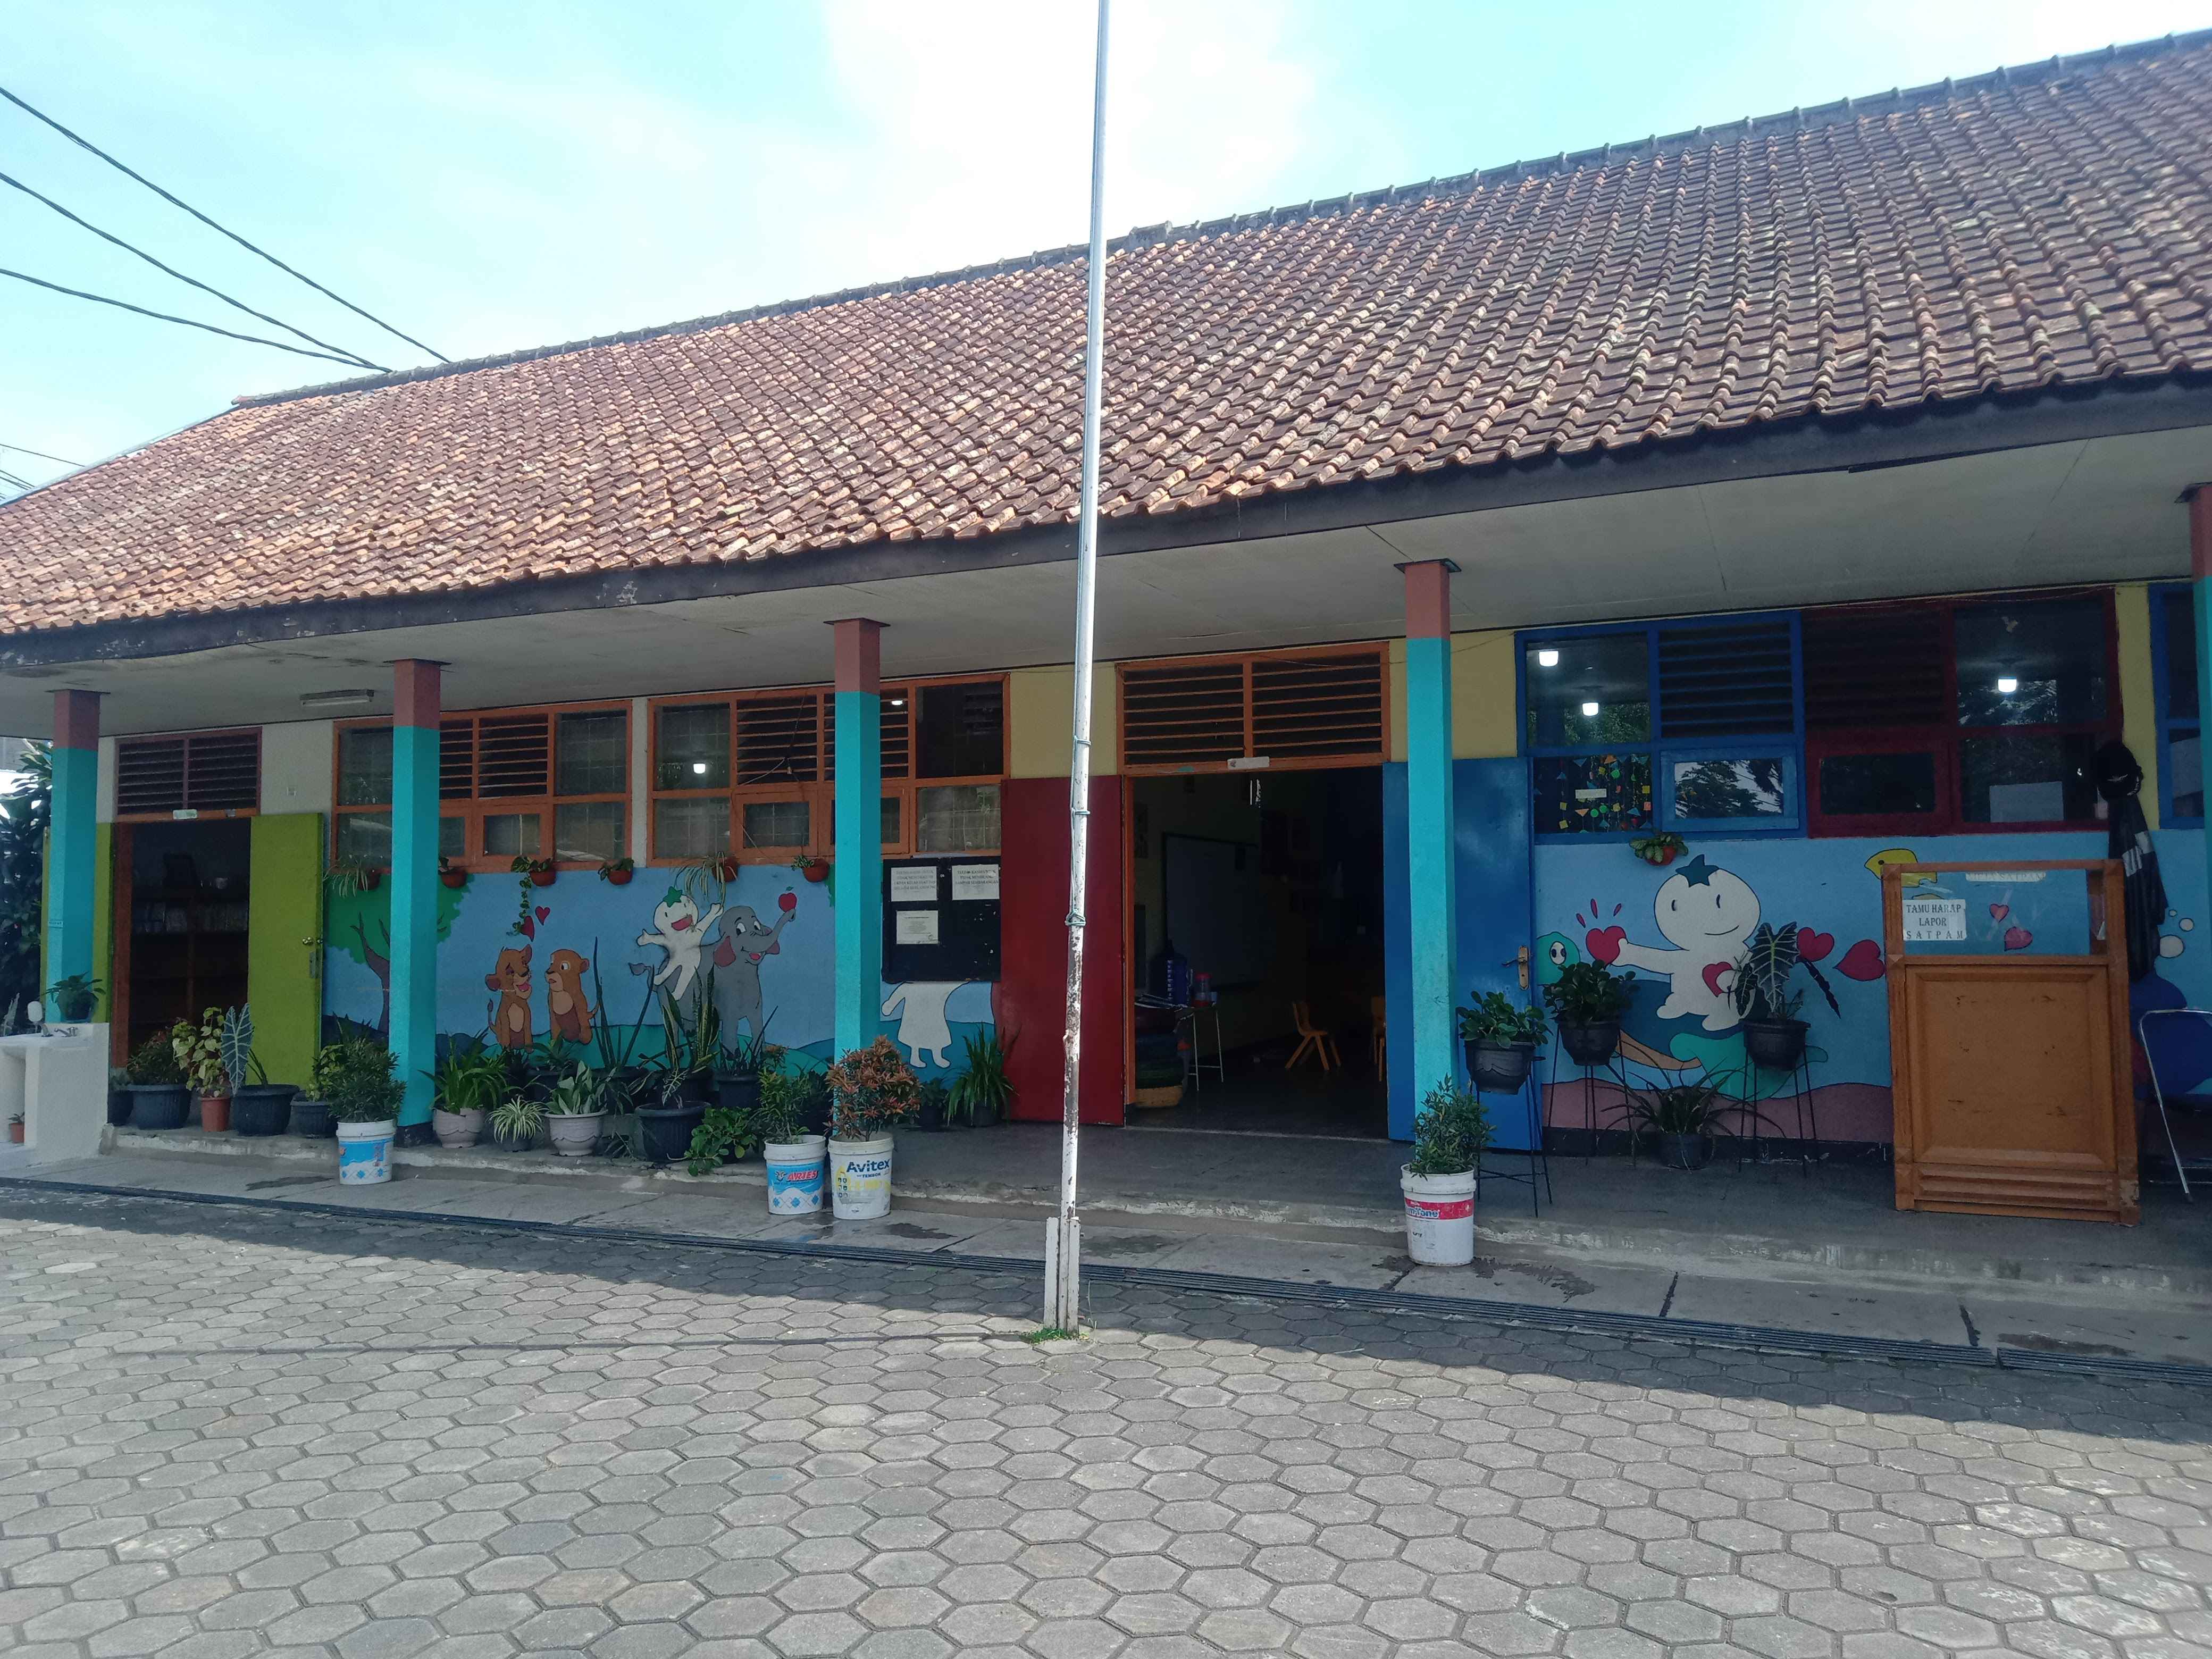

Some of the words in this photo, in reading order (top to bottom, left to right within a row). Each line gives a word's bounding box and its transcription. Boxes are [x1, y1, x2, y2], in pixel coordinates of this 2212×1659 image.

[1906, 904, 1929, 913] TAMU
[1932, 904, 1962, 913] HARAP
[1919, 917, 1947, 926] LAPOR
[847, 1159, 890, 1172] Avitex
[787, 1170, 818, 1182] ARIES
